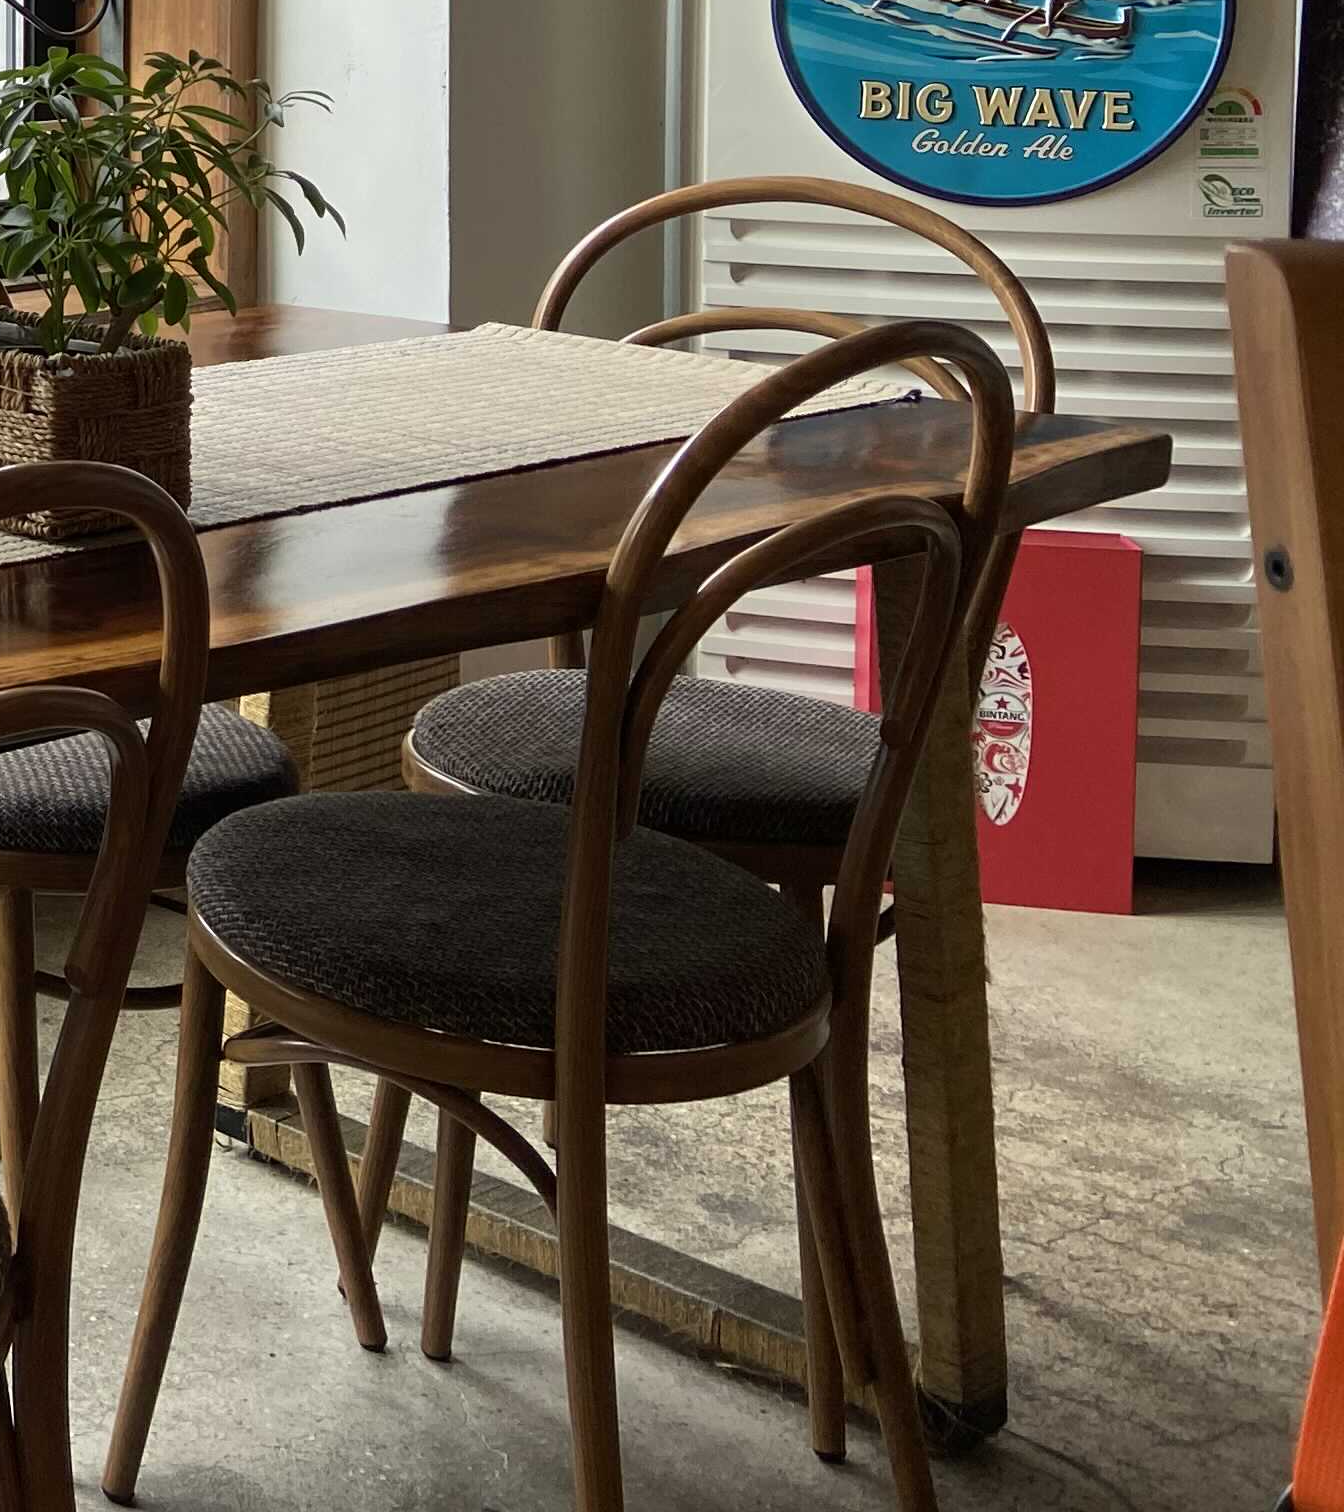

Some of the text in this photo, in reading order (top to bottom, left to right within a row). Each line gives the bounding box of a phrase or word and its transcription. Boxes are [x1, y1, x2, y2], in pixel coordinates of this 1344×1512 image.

[859, 79, 1136, 132] BIG WAVE
[911, 129, 1074, 162] Golden Ale
[1207, 207, 1260, 216] Inverter
[979, 711, 1026, 722] BINTANG
